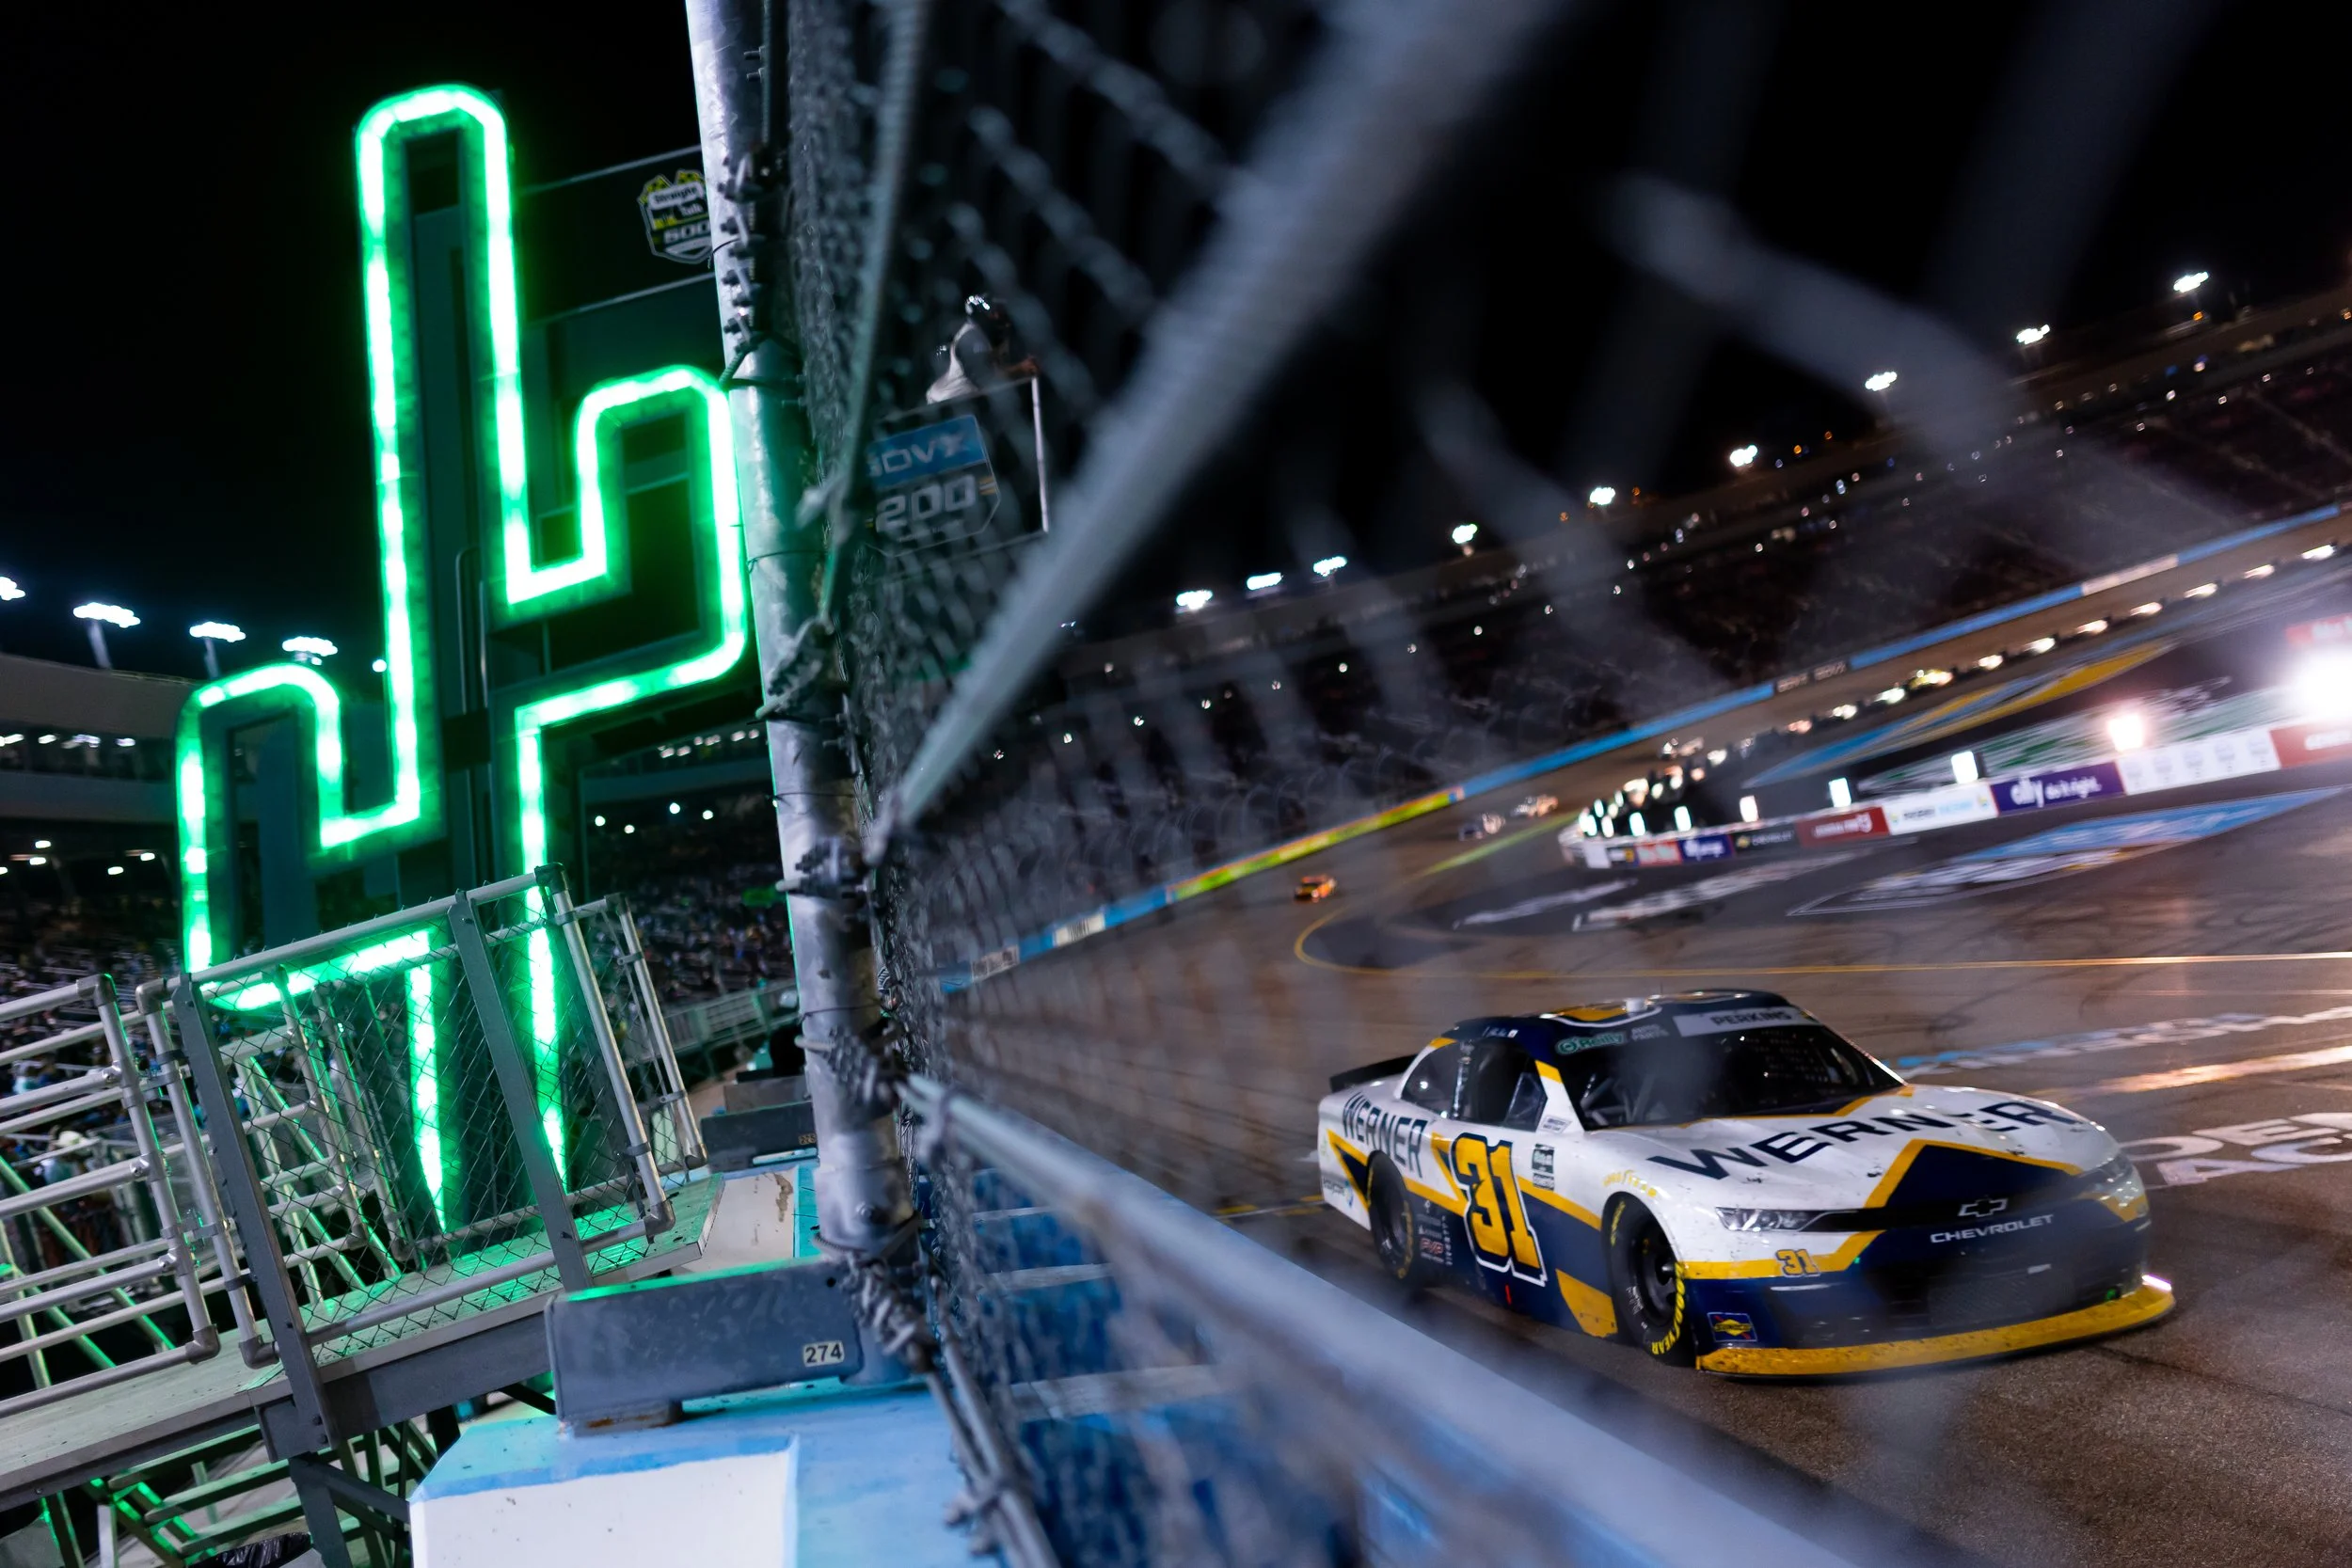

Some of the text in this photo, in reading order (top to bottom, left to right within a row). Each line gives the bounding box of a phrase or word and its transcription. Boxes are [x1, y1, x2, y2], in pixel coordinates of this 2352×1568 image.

[875, 474, 976, 533] 200
[1710, 1010, 1792, 1027] PERKINS
[1343, 1091, 1428, 1179] WERNER
[1452, 1132, 1545, 1285] 31
[1930, 1213, 2053, 1243] CHEVROLET
[1775, 1248, 1820, 1276] 31
[1652, 1262, 1685, 1354] GOODYEAR
[804, 1343, 842, 1364] 274
